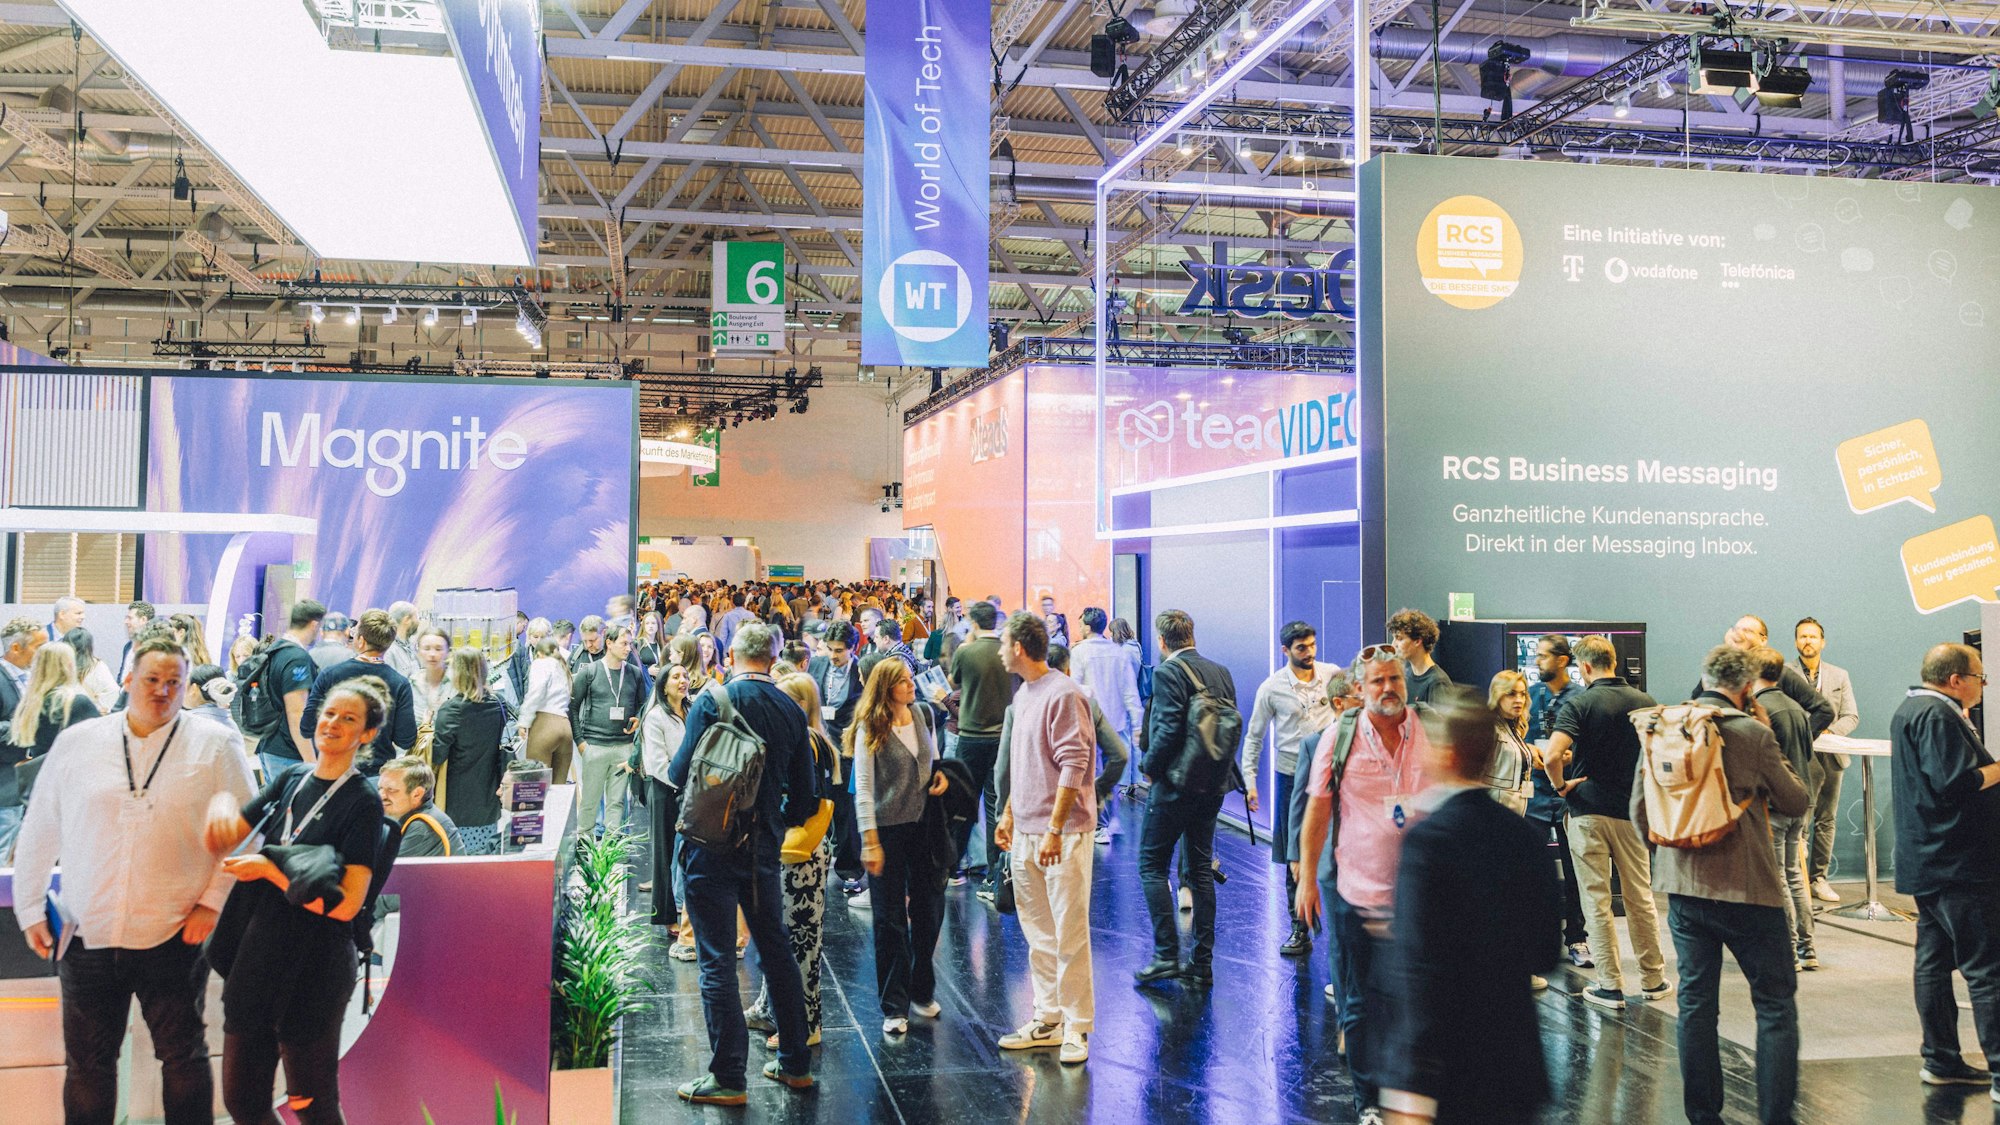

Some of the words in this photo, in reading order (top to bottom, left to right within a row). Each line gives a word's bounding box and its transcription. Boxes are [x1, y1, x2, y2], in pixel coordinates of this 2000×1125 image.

[915, 25, 942, 96] Tech
[914, 103, 941, 133] of
[914, 142, 941, 231] World
[1446, 224, 1494, 244] RCS
[1563, 224, 1602, 242] Eine
[1608, 226, 1684, 246] Initiative
[1689, 233, 1726, 248] von:
[746, 260, 779, 305] 6
[1631, 263, 1698, 280] vodafone
[1720, 262, 1796, 280] Telefónica
[905, 281, 947, 310] WT
[1431, 282, 1446, 290] DIE
[1448, 283, 1489, 292] BESSERE
[1491, 284, 1511, 293] SMS
[260, 411, 528, 497] Magnite
[665, 447, 679, 458] des
[1858, 449, 1923, 479] persönlich,
[1443, 455, 1500, 481] RCS
[1509, 457, 1629, 483] Business
[1637, 459, 1778, 491] Messaging
[1863, 481, 1875, 494] in
[1877, 465, 1929, 488] Echtzeit.
[1453, 503, 1586, 524] Ganzheitliche
[1592, 506, 1769, 530] Kundenansprache.
[1466, 533, 1525, 552] Direkt
[1531, 534, 1547, 552] in
[1554, 534, 1586, 553] der
[1592, 535, 1695, 558] Messaging
[1702, 536, 1758, 555] Inbox.
[1911, 540, 1995, 575] Kundenbindung
[1923, 573, 1943, 586] neu
[1945, 555, 1996, 580] gestalten.
